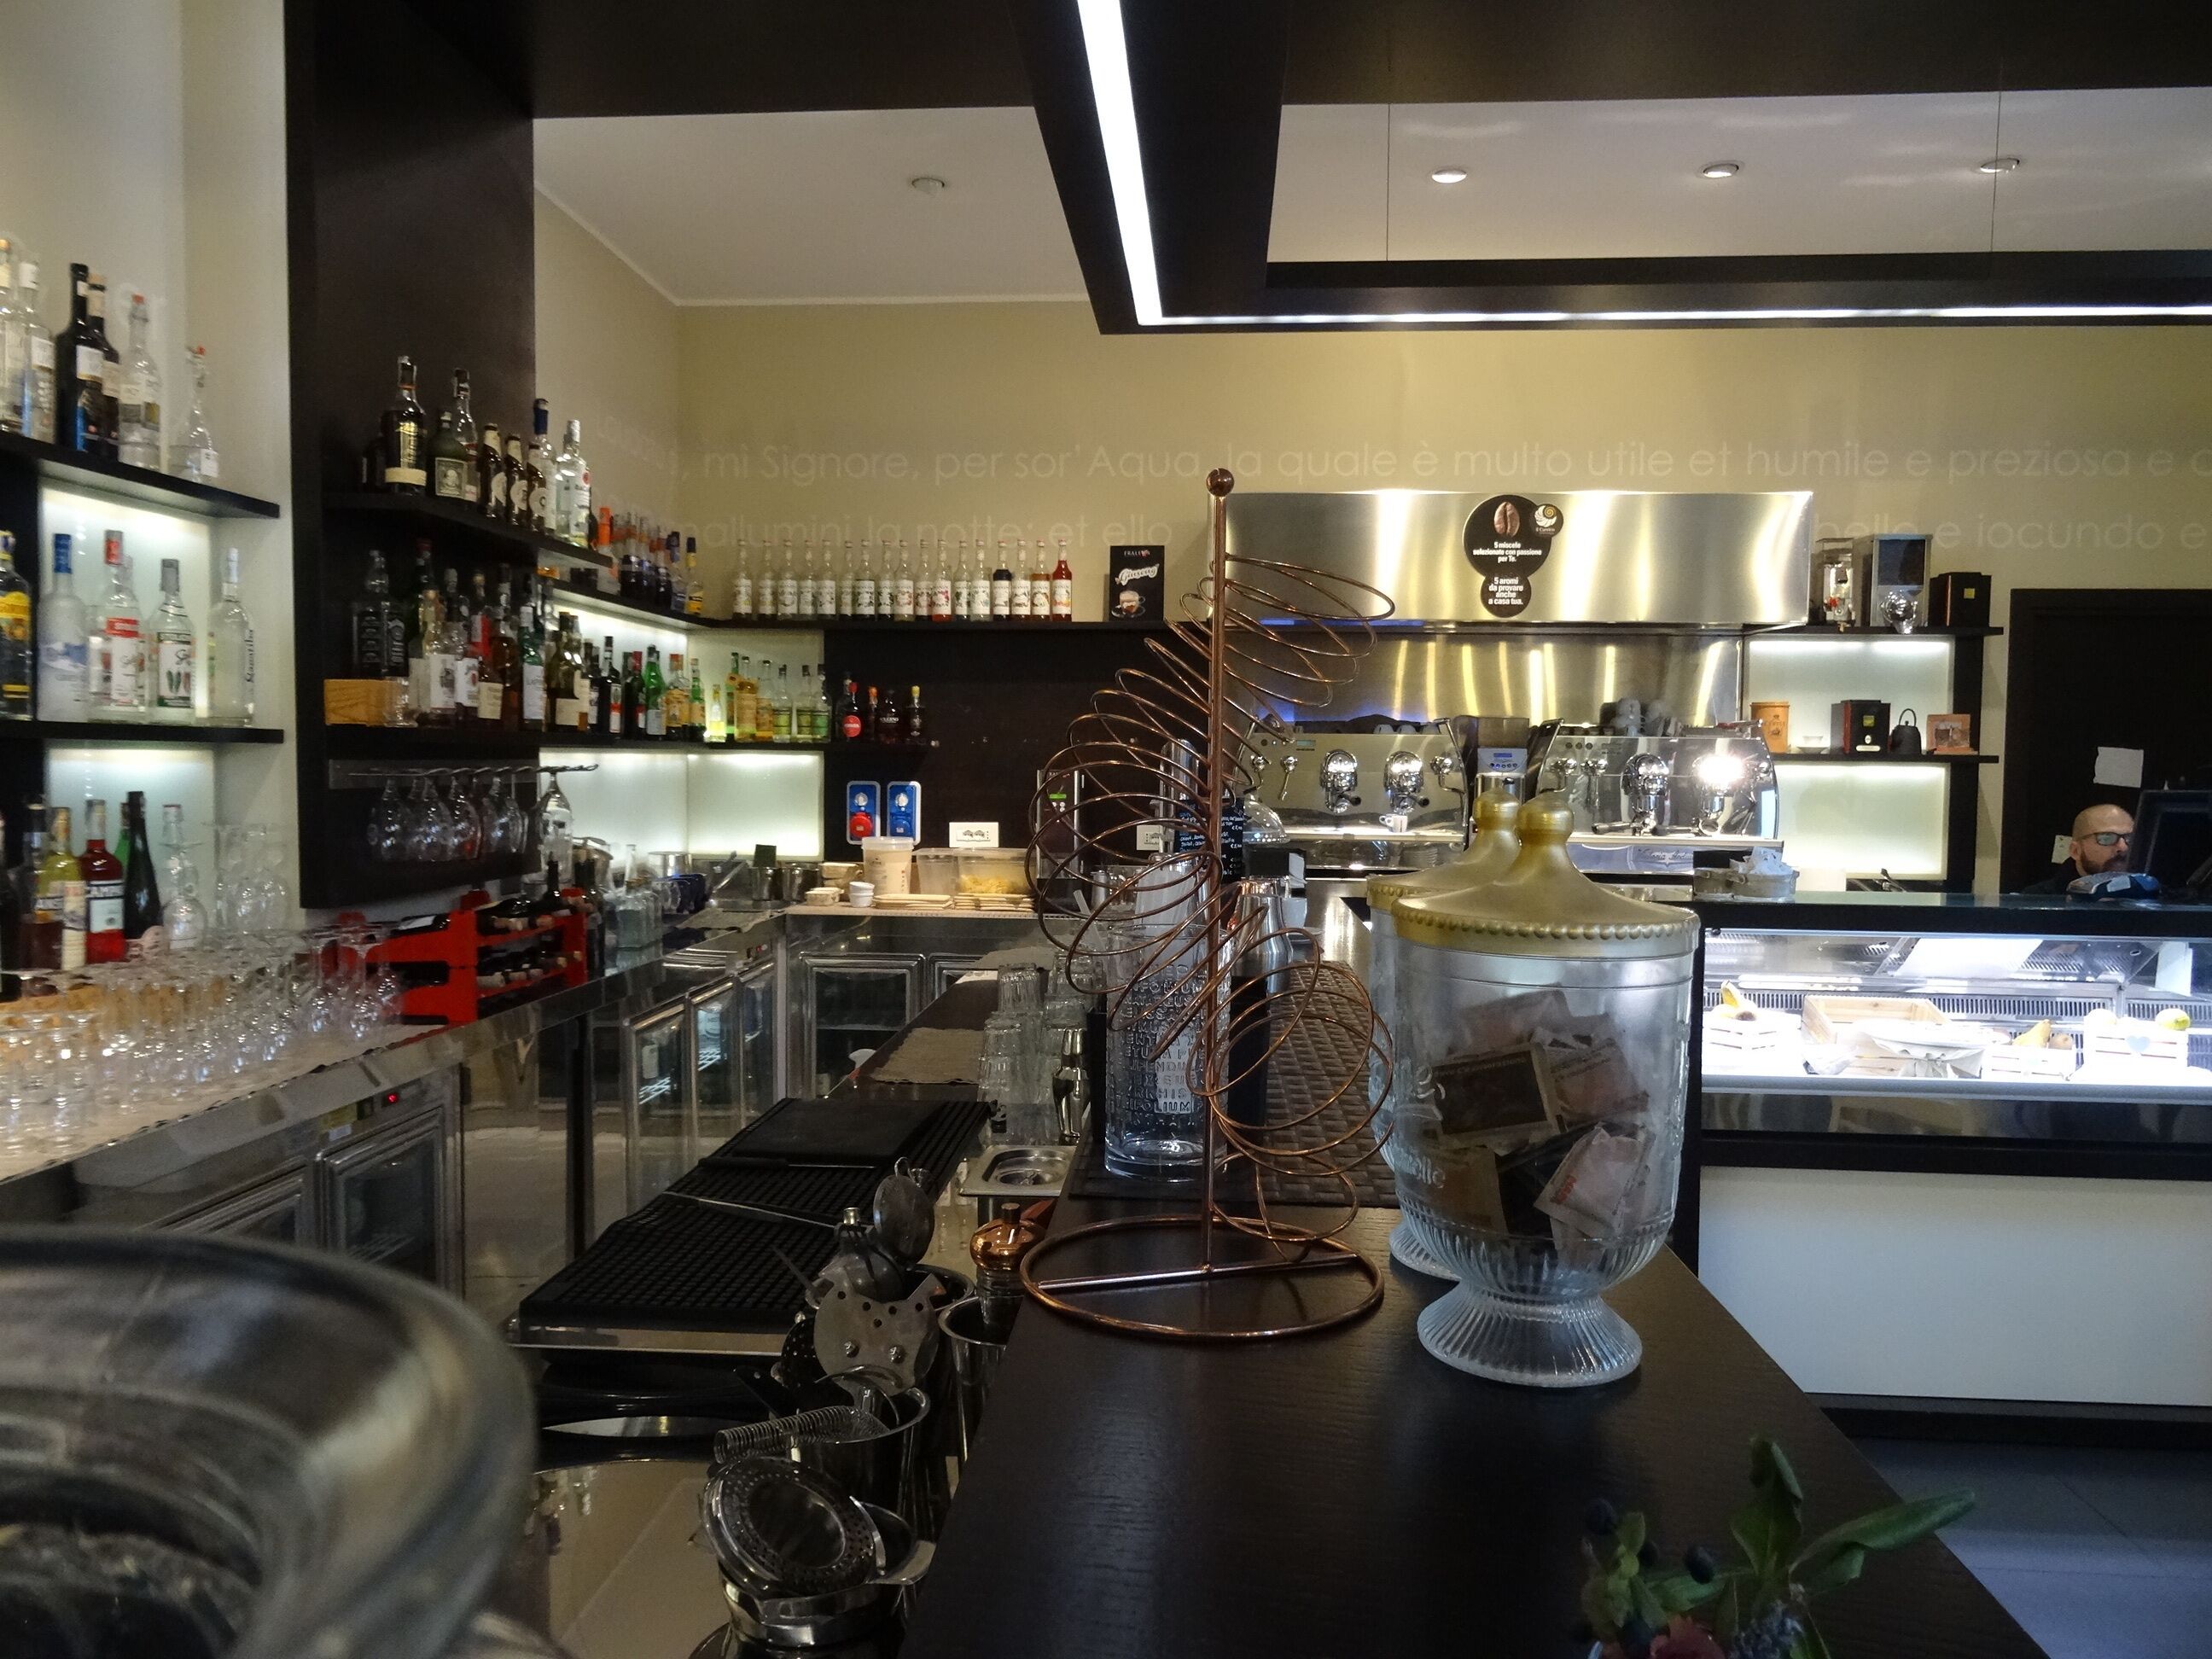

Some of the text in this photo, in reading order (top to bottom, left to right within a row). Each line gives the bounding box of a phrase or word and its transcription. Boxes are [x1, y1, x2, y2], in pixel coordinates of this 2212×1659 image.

[704, 444, 748, 478] mi
[760, 445, 920, 487] Signore,
[936, 452, 1003, 486] per
[1228, 442, 1262, 477] la
[1278, 442, 1397, 485] quale
[1412, 440, 1440, 477] è
[1454, 441, 1573, 476] multo
[1587, 441, 1674, 476] utile
[1690, 441, 1732, 476] et
[1748, 441, 1889, 477] humile
[1906, 449, 1932, 477] e
[1949, 439, 2130, 485] preziosa
[2147, 449, 2174, 477] e
[868, 515, 901, 548] la
[1048, 514, 1091, 548] et
[1102, 514, 1173, 546] ello
[1935, 521, 1961, 549] e
[1977, 512, 2165, 550] iocundo
[2180, 522, 2207, 550] e
